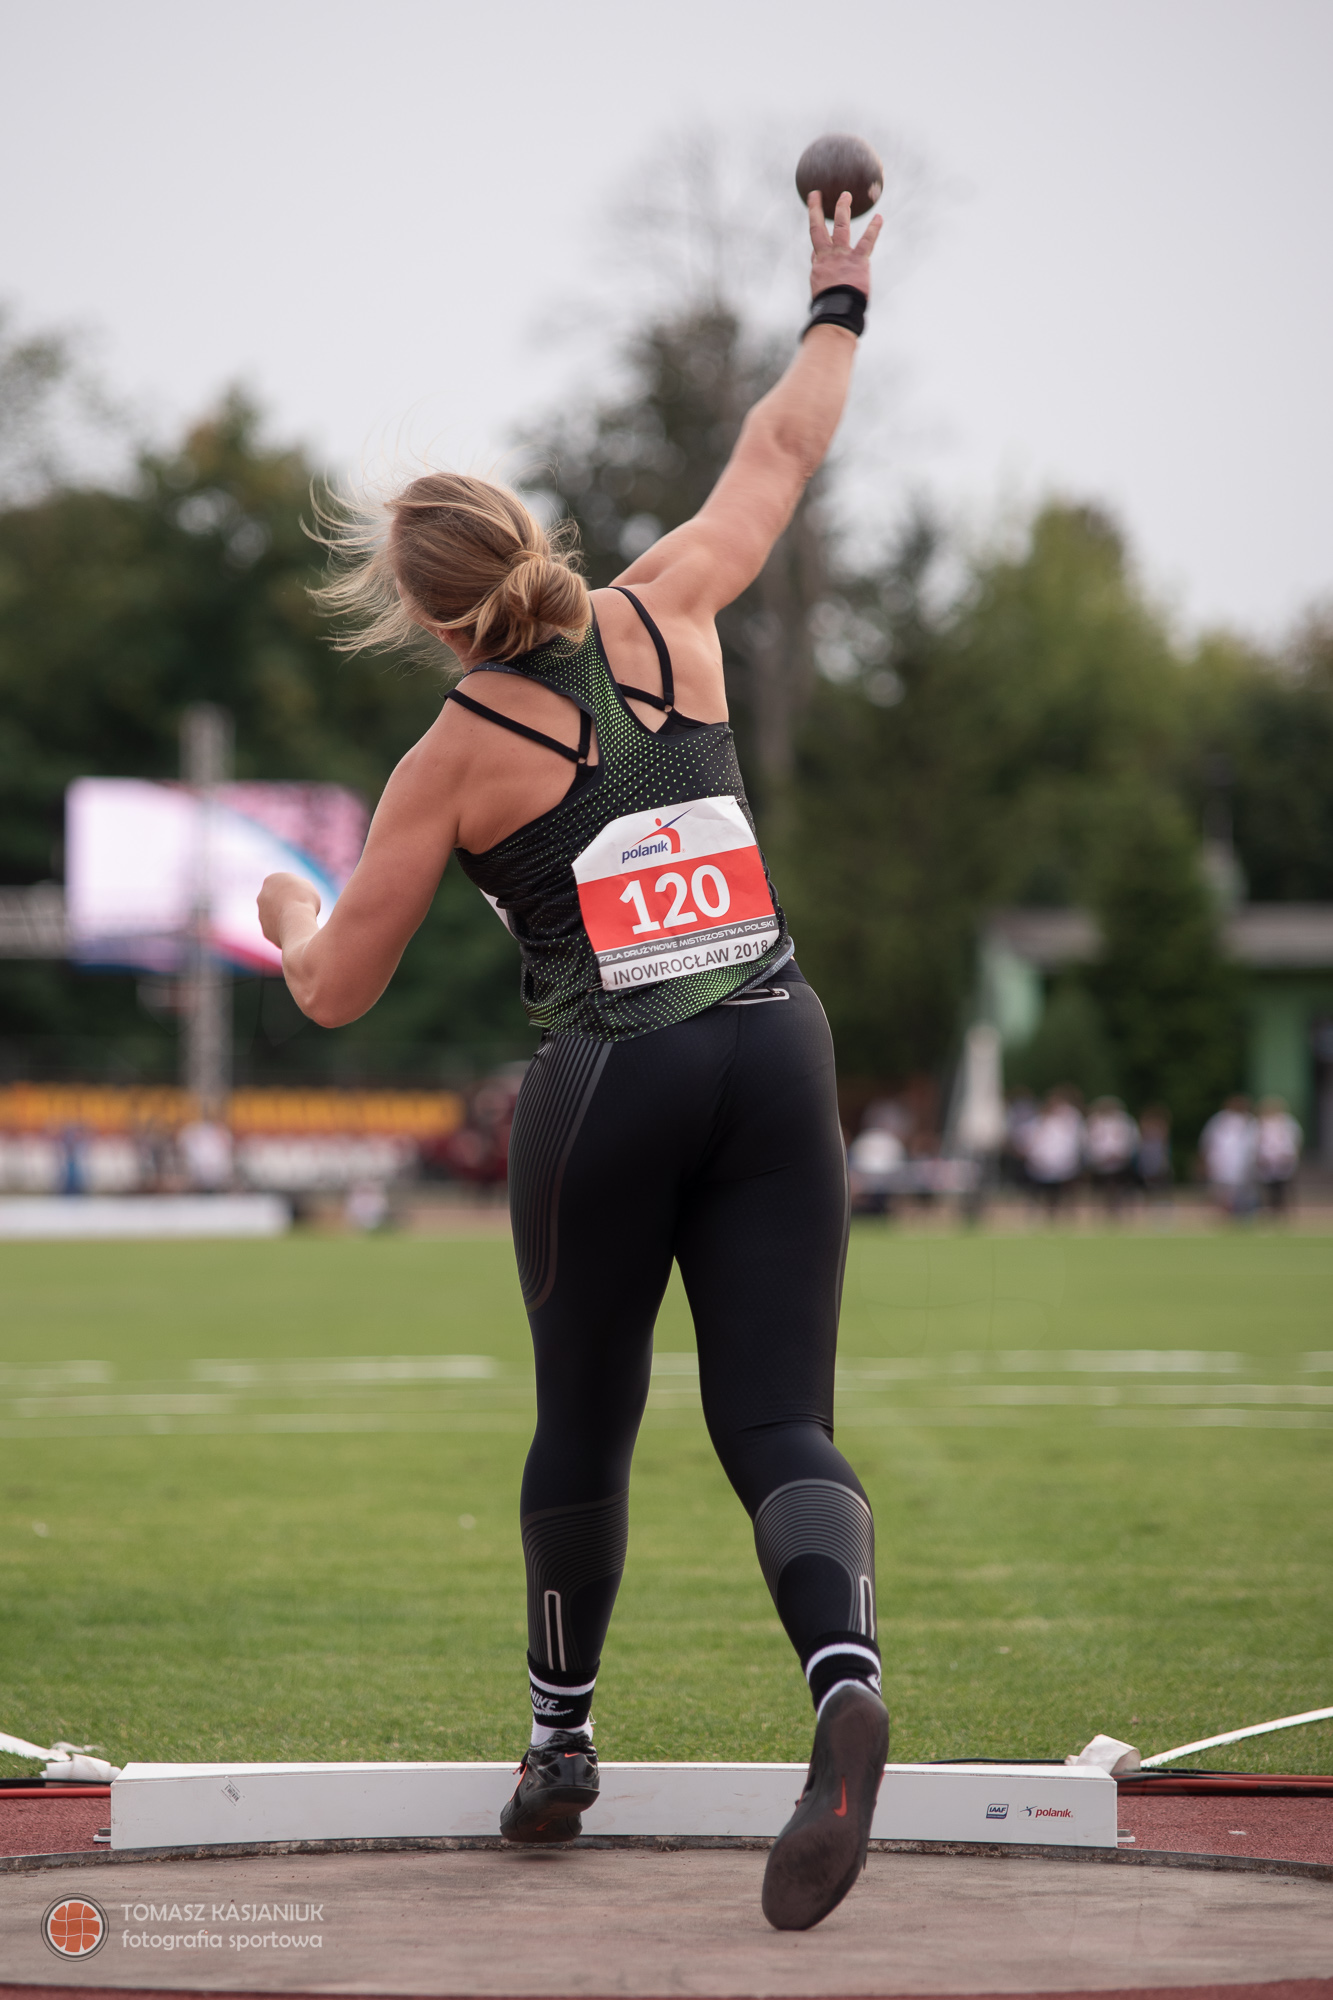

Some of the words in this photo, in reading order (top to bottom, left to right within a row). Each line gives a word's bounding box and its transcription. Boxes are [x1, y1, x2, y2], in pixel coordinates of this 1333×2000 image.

[622, 840, 668, 864] polanik
[619, 864, 731, 935] 120
[599, 951, 622, 963] PZLA
[623, 940, 678, 958] DRUŻYNOWE
[679, 926, 744, 946] MISTRZOSTWA
[744, 919, 775, 933] POLSKI
[613, 947, 730, 985] INOWROCŁAW
[734, 939, 769, 959] 2018
[1035, 1808, 1072, 1818] polanik
